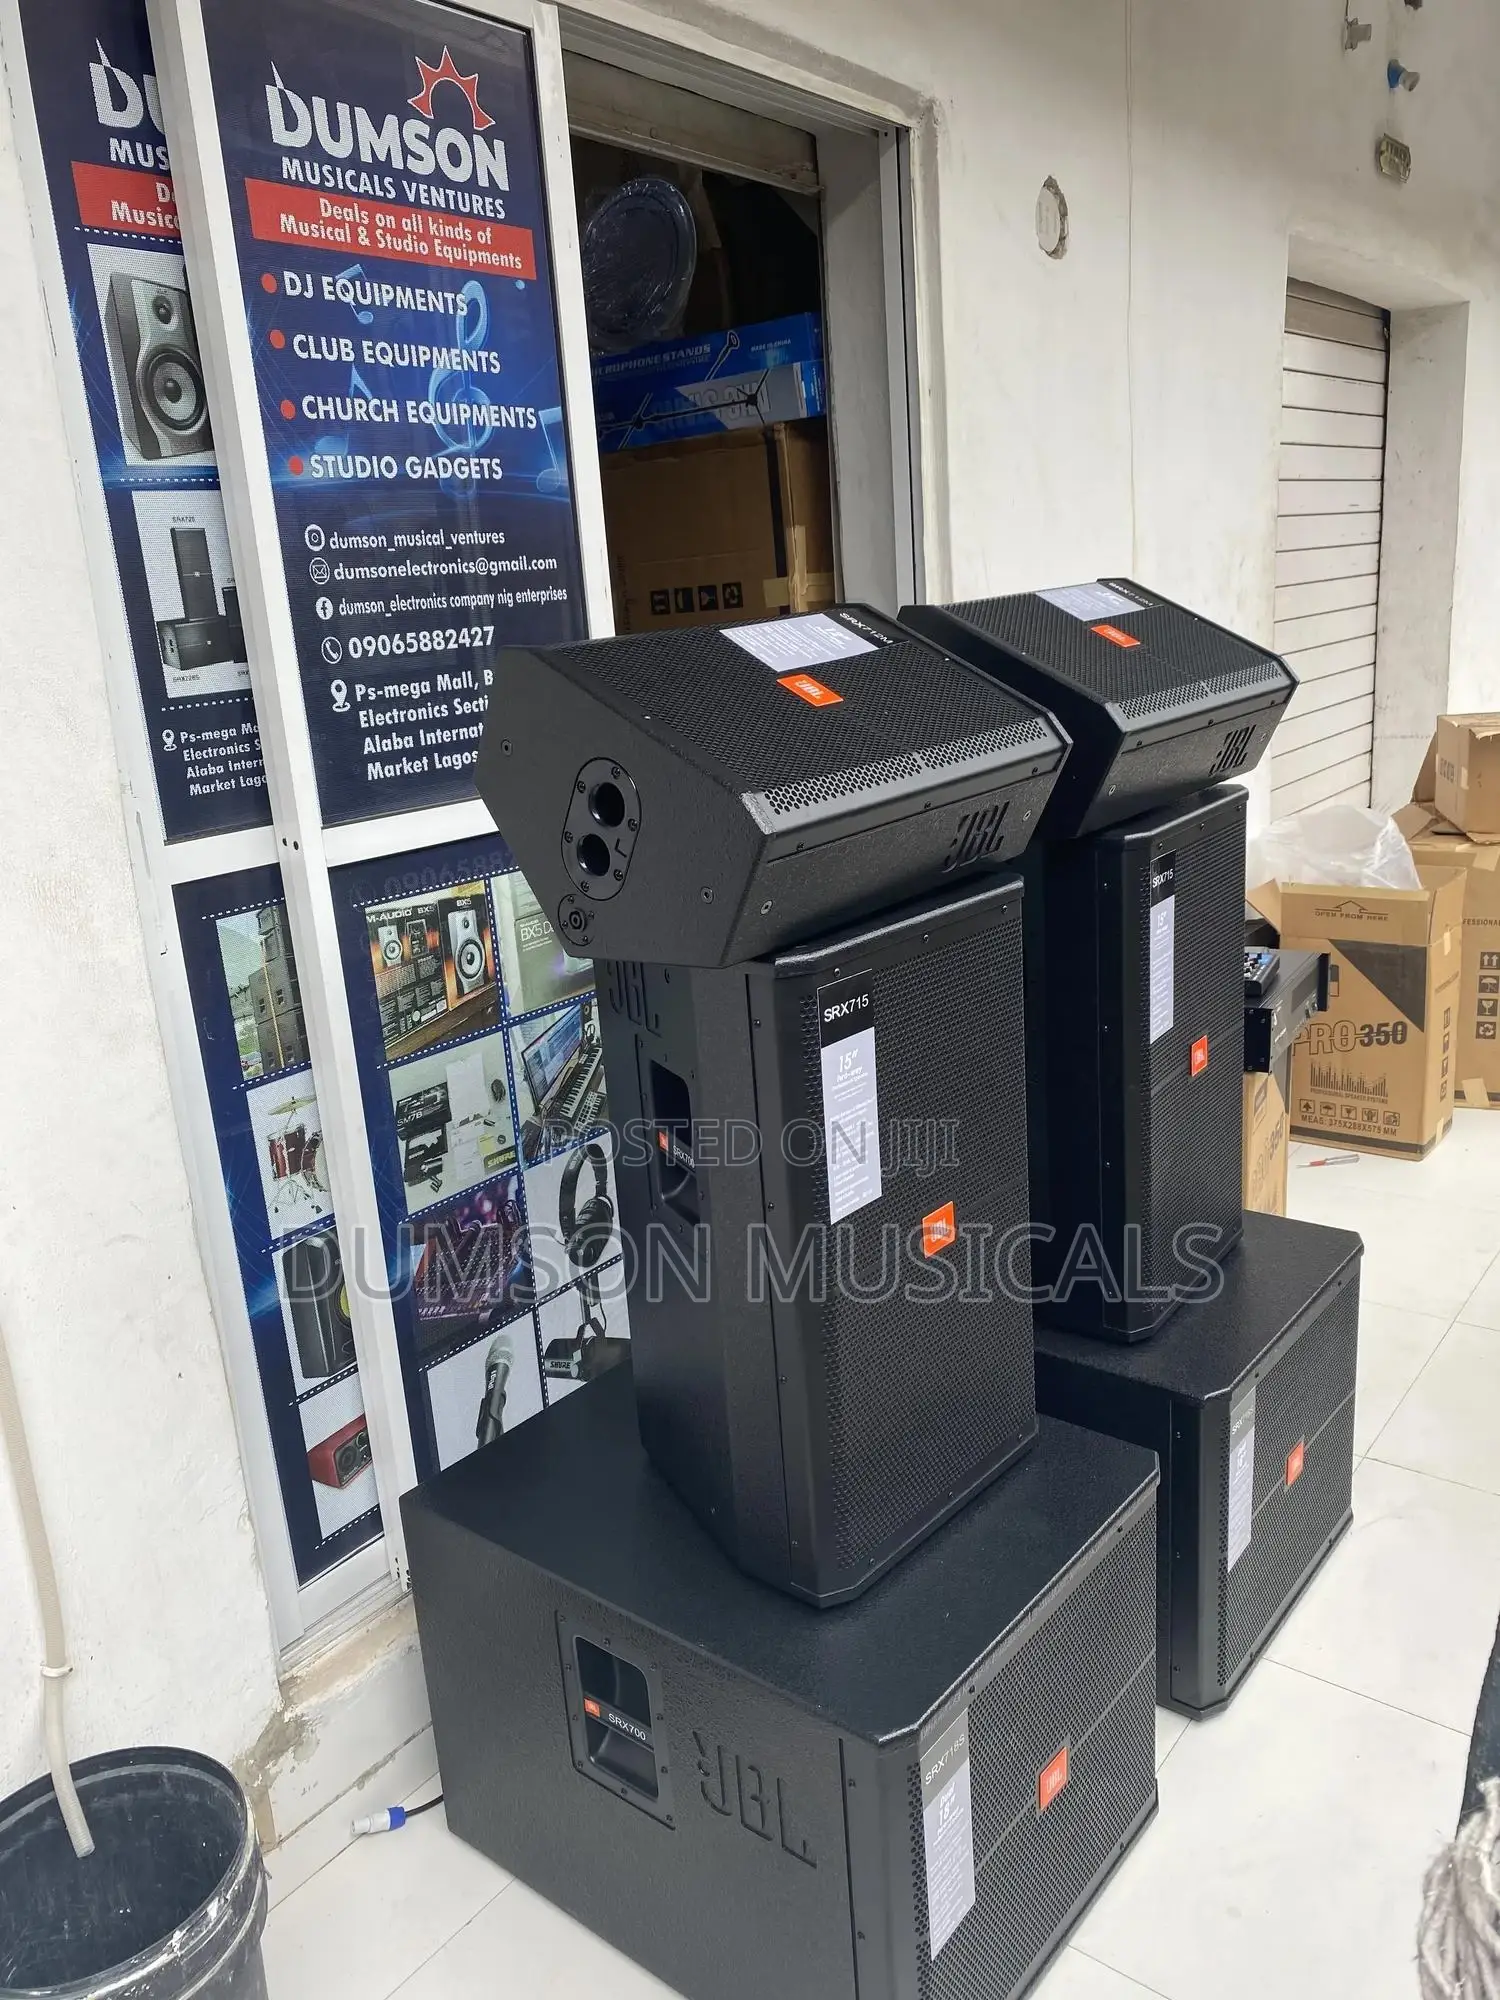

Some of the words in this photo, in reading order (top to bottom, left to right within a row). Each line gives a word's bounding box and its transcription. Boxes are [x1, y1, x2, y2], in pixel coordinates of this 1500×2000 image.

[265, 60, 510, 192] DUMSON
[281, 156, 397, 199] MUSICALS
[402, 180, 506, 220] VENTURES
[319, 197, 369, 225] Deals
[375, 211, 396, 230] on
[401, 213, 423, 234] all
[428, 214, 473, 243] kinds
[477, 226, 493, 245] of
[279, 212, 351, 244] Musical
[357, 226, 371, 247] &
[375, 229, 429, 255] Studio
[434, 239, 523, 270] Equipments
[283, 270, 314, 299] DJ
[321, 275, 468, 317] EQUIPMENTS
[292, 333, 355, 363] CLUB
[361, 339, 501, 374] EQUIPMENTS
[663, 343, 712, 362] STANDS
[301, 394, 400, 423] CHURCH
[405, 399, 537, 430] EQUIPMENTS
[310, 453, 398, 480] STUDIO
[404, 455, 503, 481] GADGETS
[329, 529, 505, 552] dumson_musical_ventures
[333, 555, 558, 581] dumsonelectronics@gmail.com
[338, 592, 447, 618] dumson_electronics
[449, 593, 495, 611] company
[497, 587, 514, 608] nig
[515, 585, 568, 602] enterprises
[348, 625, 495, 659] 09065882427
[839, 612, 894, 645] SRX712M
[354, 678, 431, 702] Ps-mega
[436, 670, 479, 692] Mall,
[358, 702, 449, 729] Electronics
[179, 727, 237, 744] Ps-mega
[362, 732, 415, 755] Alaba
[419, 722, 484, 747] Internat
[182, 742, 251, 762] Electronics
[367, 756, 429, 781] Market
[433, 749, 479, 770] Lagos
[186, 763, 225, 780] Alaba
[189, 778, 236, 797] Market
[1152, 868, 1174, 888] SRX715
[1340, 912, 1364, 920] FROM
[520, 922, 543, 942] BX5
[823, 994, 870, 1023] SRX715
[397, 1111, 423, 1127] SM7B
[1383, 1127, 1397, 1137] MM
[550, 1360, 571, 1370] SHURE
[608, 1713, 646, 1741] SRX700
[925, 1734, 965, 1785] SRX718S
[691, 1730, 818, 1870] JBL
